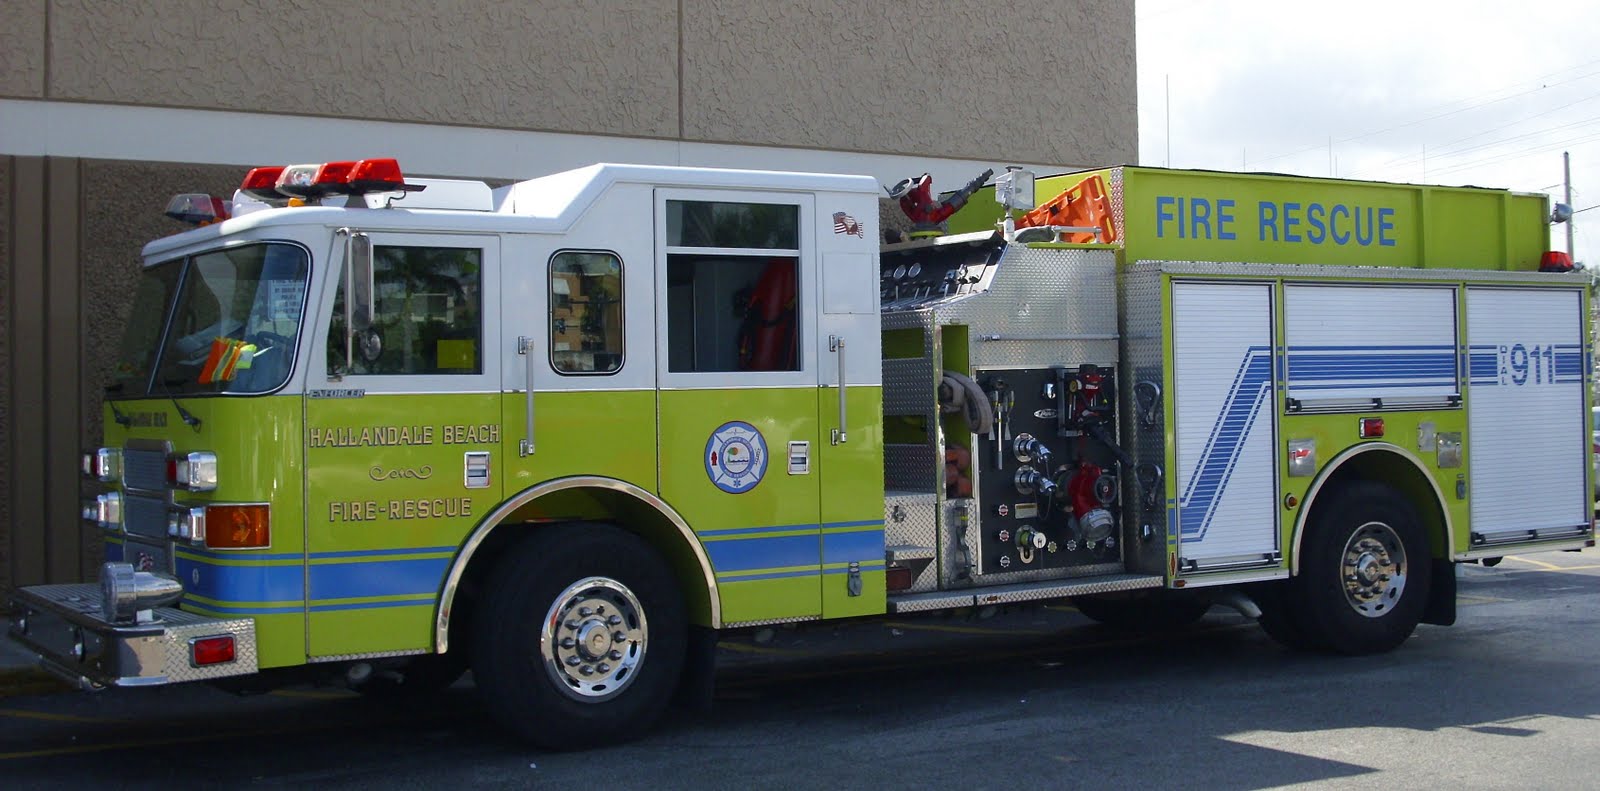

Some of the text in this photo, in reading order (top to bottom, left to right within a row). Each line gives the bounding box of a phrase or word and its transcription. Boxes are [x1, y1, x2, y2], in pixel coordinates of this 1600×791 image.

[1156, 196, 1396, 246] FIRE RESCUE
[1499, 345, 1508, 386] DIAL
[1510, 343, 1553, 386] 911
[309, 388, 366, 399] ENFORCER
[309, 424, 500, 448] HALLANDALE BEACH
[329, 497, 472, 522] FIRE-RESCUE
